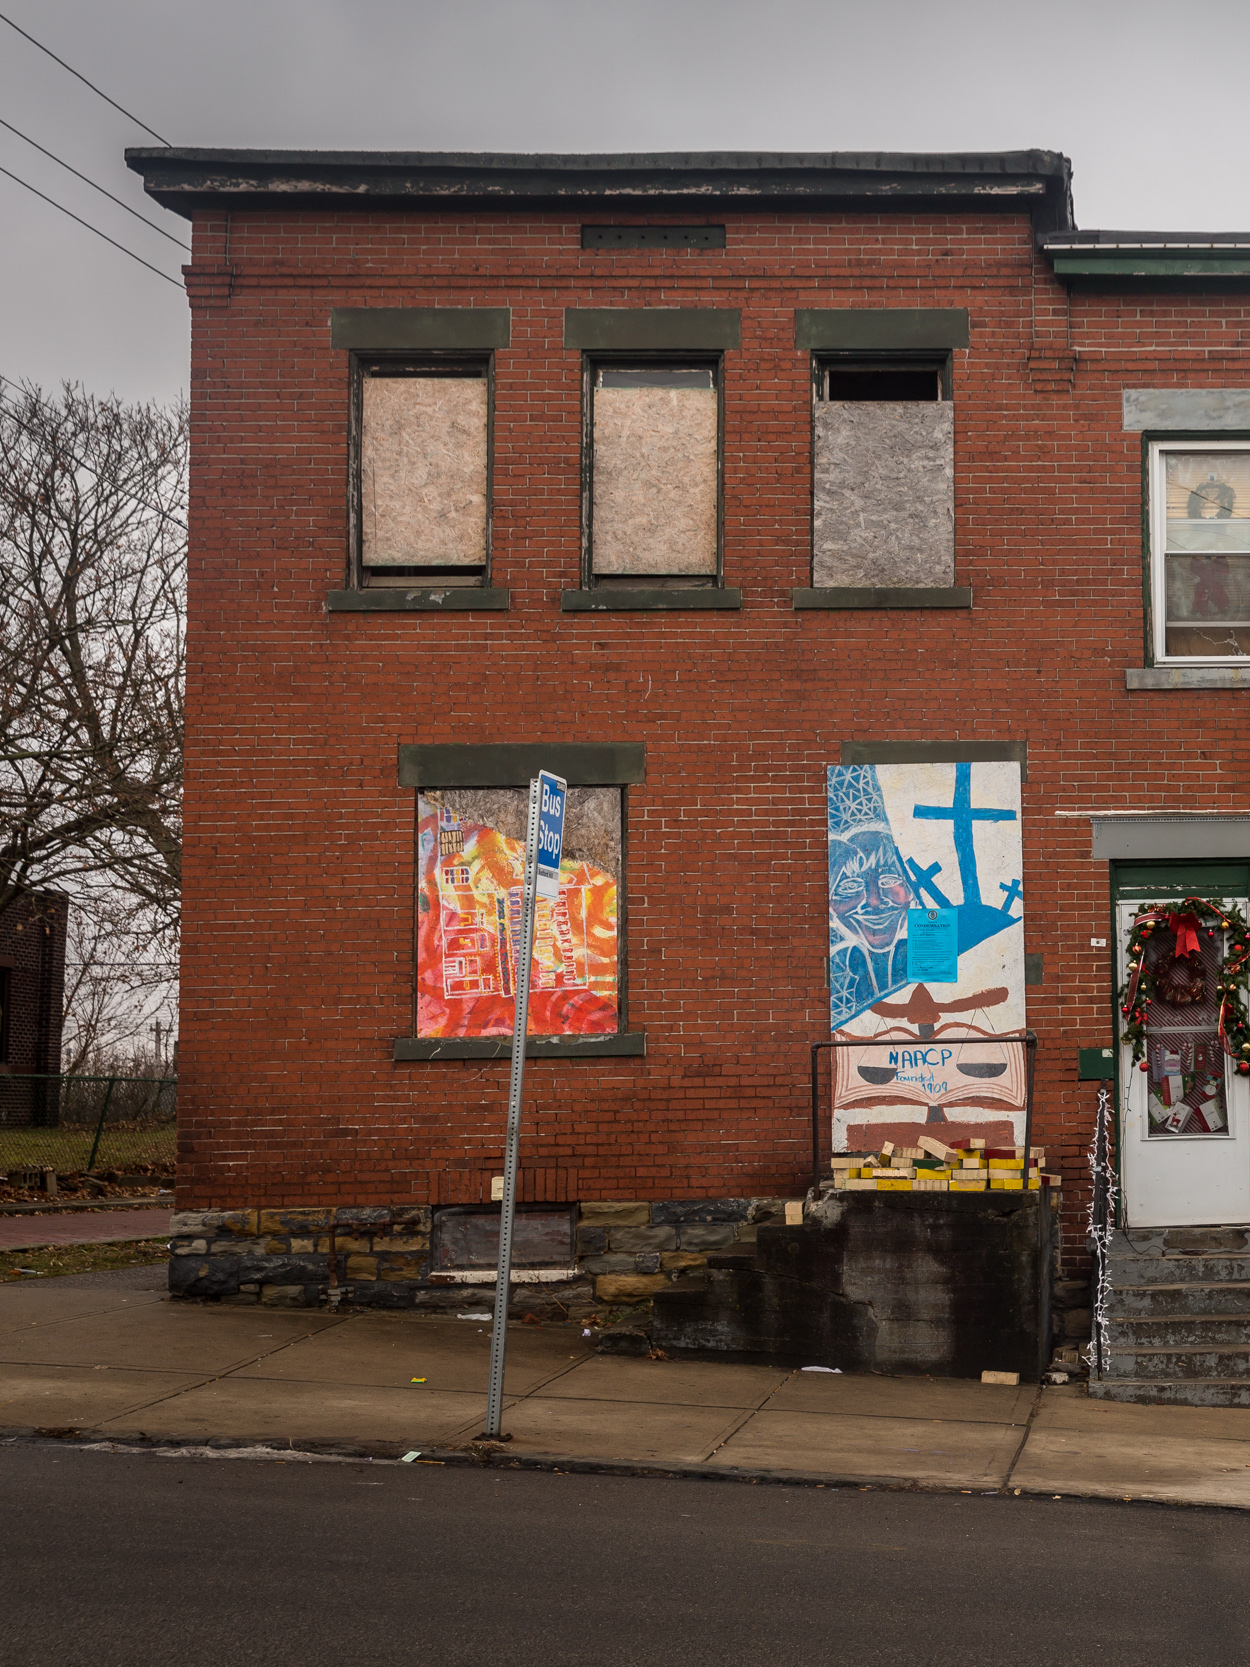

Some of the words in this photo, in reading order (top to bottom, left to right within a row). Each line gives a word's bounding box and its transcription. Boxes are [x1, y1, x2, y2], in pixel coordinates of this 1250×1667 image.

[542, 784, 561, 818] Bus
[539, 820, 560, 860] Stop
[889, 1048, 952, 1069] NAACP
[895, 1070, 935, 1083] Founded
[922, 1081, 948, 1094] 1909
